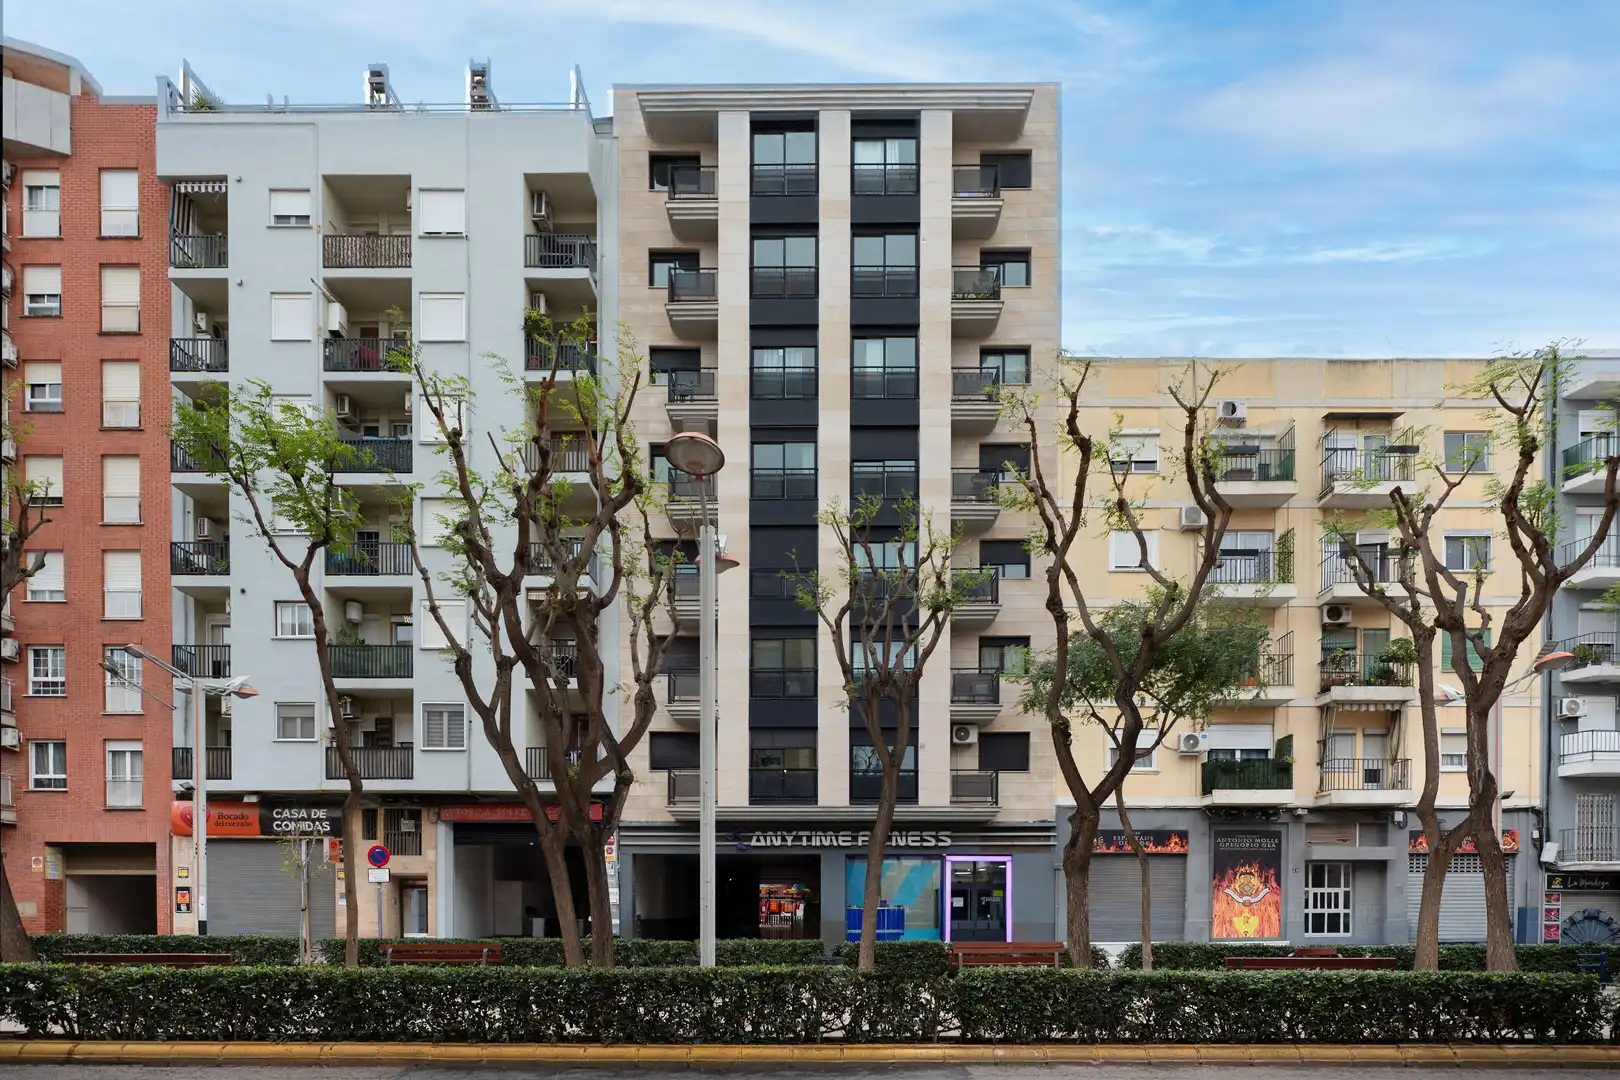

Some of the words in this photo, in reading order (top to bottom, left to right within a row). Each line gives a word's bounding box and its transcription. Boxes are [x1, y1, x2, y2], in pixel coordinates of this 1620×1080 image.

[218, 812, 249, 820] Bocado
[272, 809, 307, 818] CASA
[311, 809, 327, 818] DE
[273, 821, 331, 831] COMIDAS
[750, 831, 852, 847] ANYTIME
[857, 831, 952, 847] FNESS
[1568, 877, 1578, 887] La
